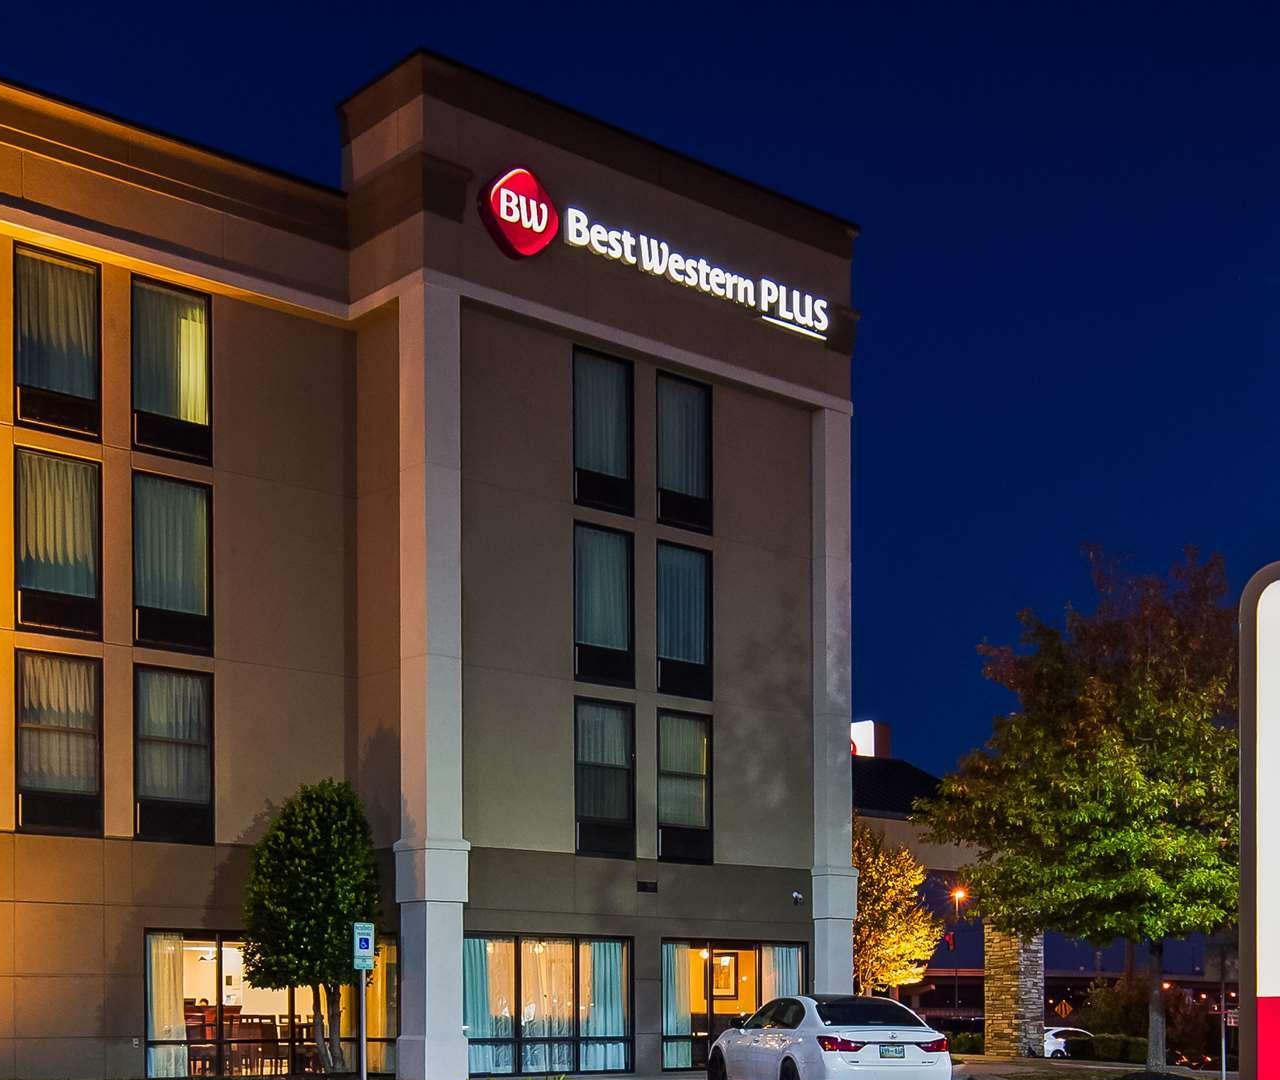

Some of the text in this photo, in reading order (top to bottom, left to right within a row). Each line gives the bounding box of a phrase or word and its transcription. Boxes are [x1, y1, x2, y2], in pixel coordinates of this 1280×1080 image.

[500, 188, 548, 233] BW
[567, 208, 829, 331] Best Western PLUS
